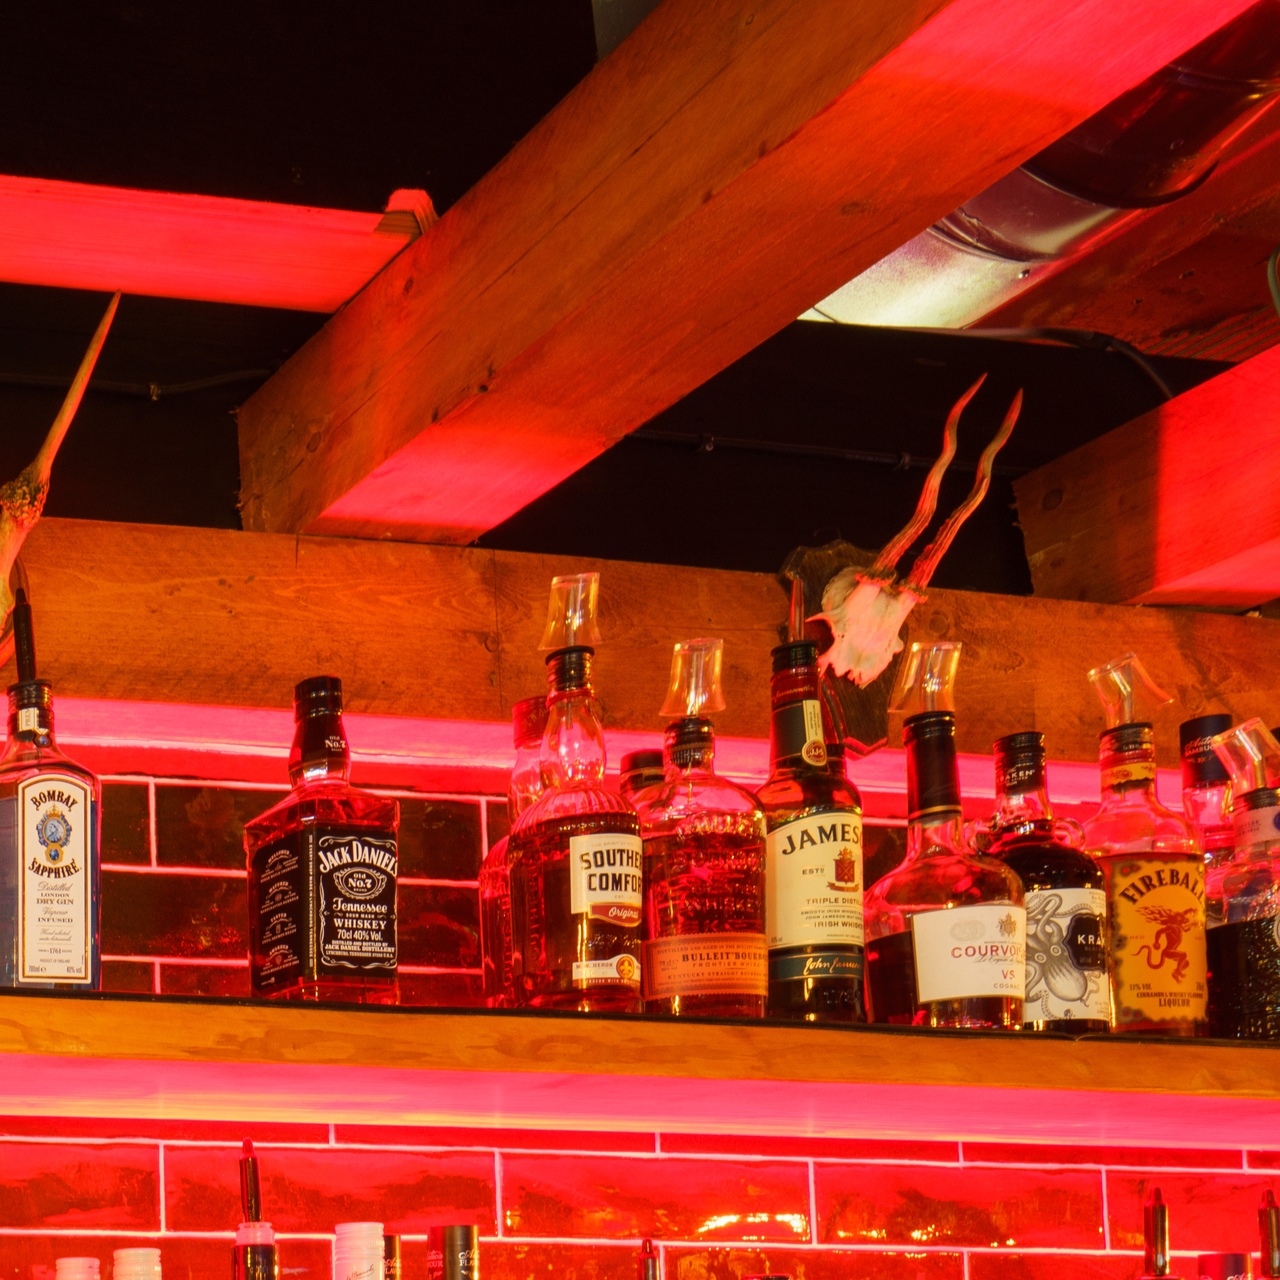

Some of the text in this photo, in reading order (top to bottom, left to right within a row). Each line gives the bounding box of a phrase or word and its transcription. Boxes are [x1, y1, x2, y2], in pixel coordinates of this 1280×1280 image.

[325, 739, 346, 750] No.7
[30, 789, 80, 812] BOMBAY
[318, 845, 352, 874] JACK
[28, 857, 81, 880] SAPPHIRE
[37, 881, 74, 892] Distilled
[348, 878, 373, 889] No.7
[36, 898, 75, 906] DRY GIN
[332, 896, 388, 914] Tennessee
[333, 918, 388, 930] WHISKEY
[337, 929, 383, 941] 70cl 40% Vol.
[692, 961, 737, 969] FRONTIER
[1001, 968, 1016, 981] VS
[1158, 997, 1191, 1008] LIQUEUR
